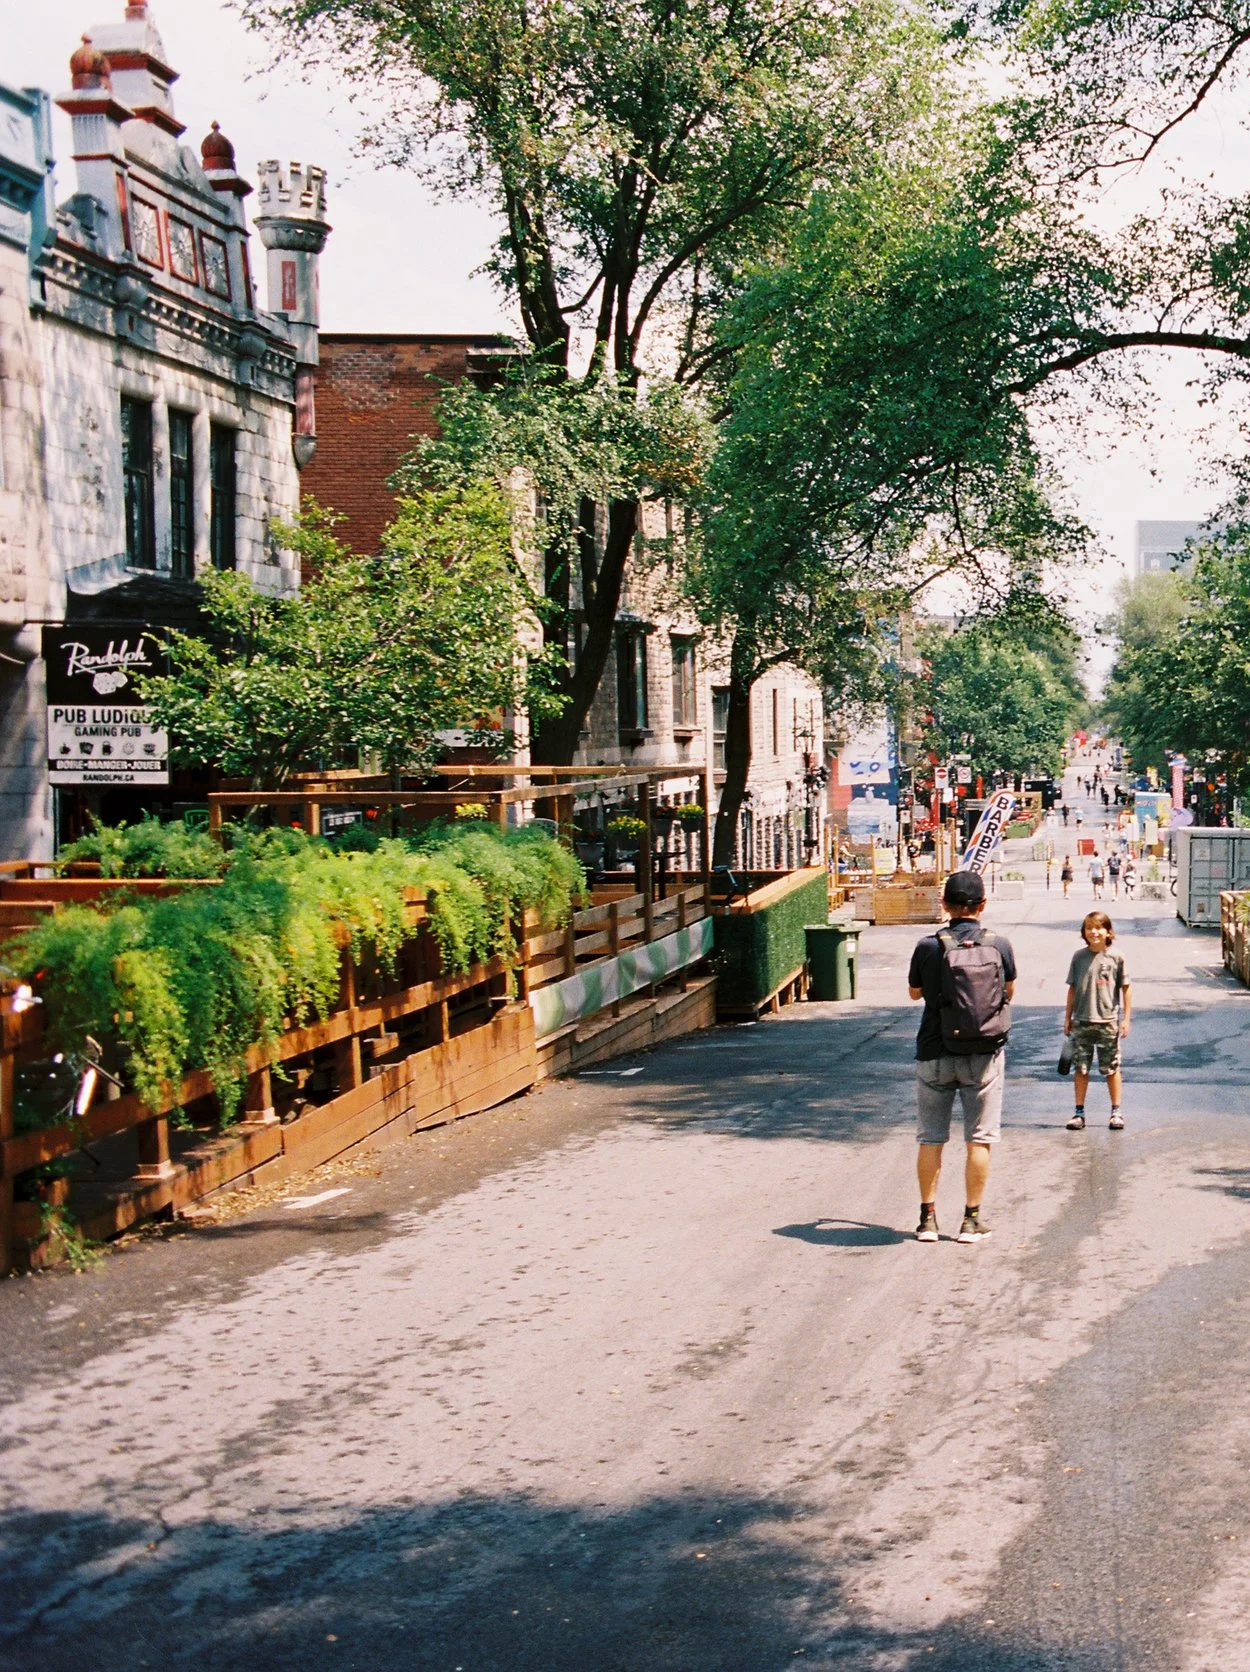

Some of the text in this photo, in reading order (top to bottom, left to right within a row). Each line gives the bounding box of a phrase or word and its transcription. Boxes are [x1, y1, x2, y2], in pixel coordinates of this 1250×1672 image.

[61, 639, 152, 676] Randolph
[54, 709, 87, 723] PUB
[74, 727, 142, 737] GAMING PUB
[131, 761, 161, 771] JOUER
[83, 774, 135, 782] RANDOLPH.CA
[969, 796, 1009, 875] BARBER
